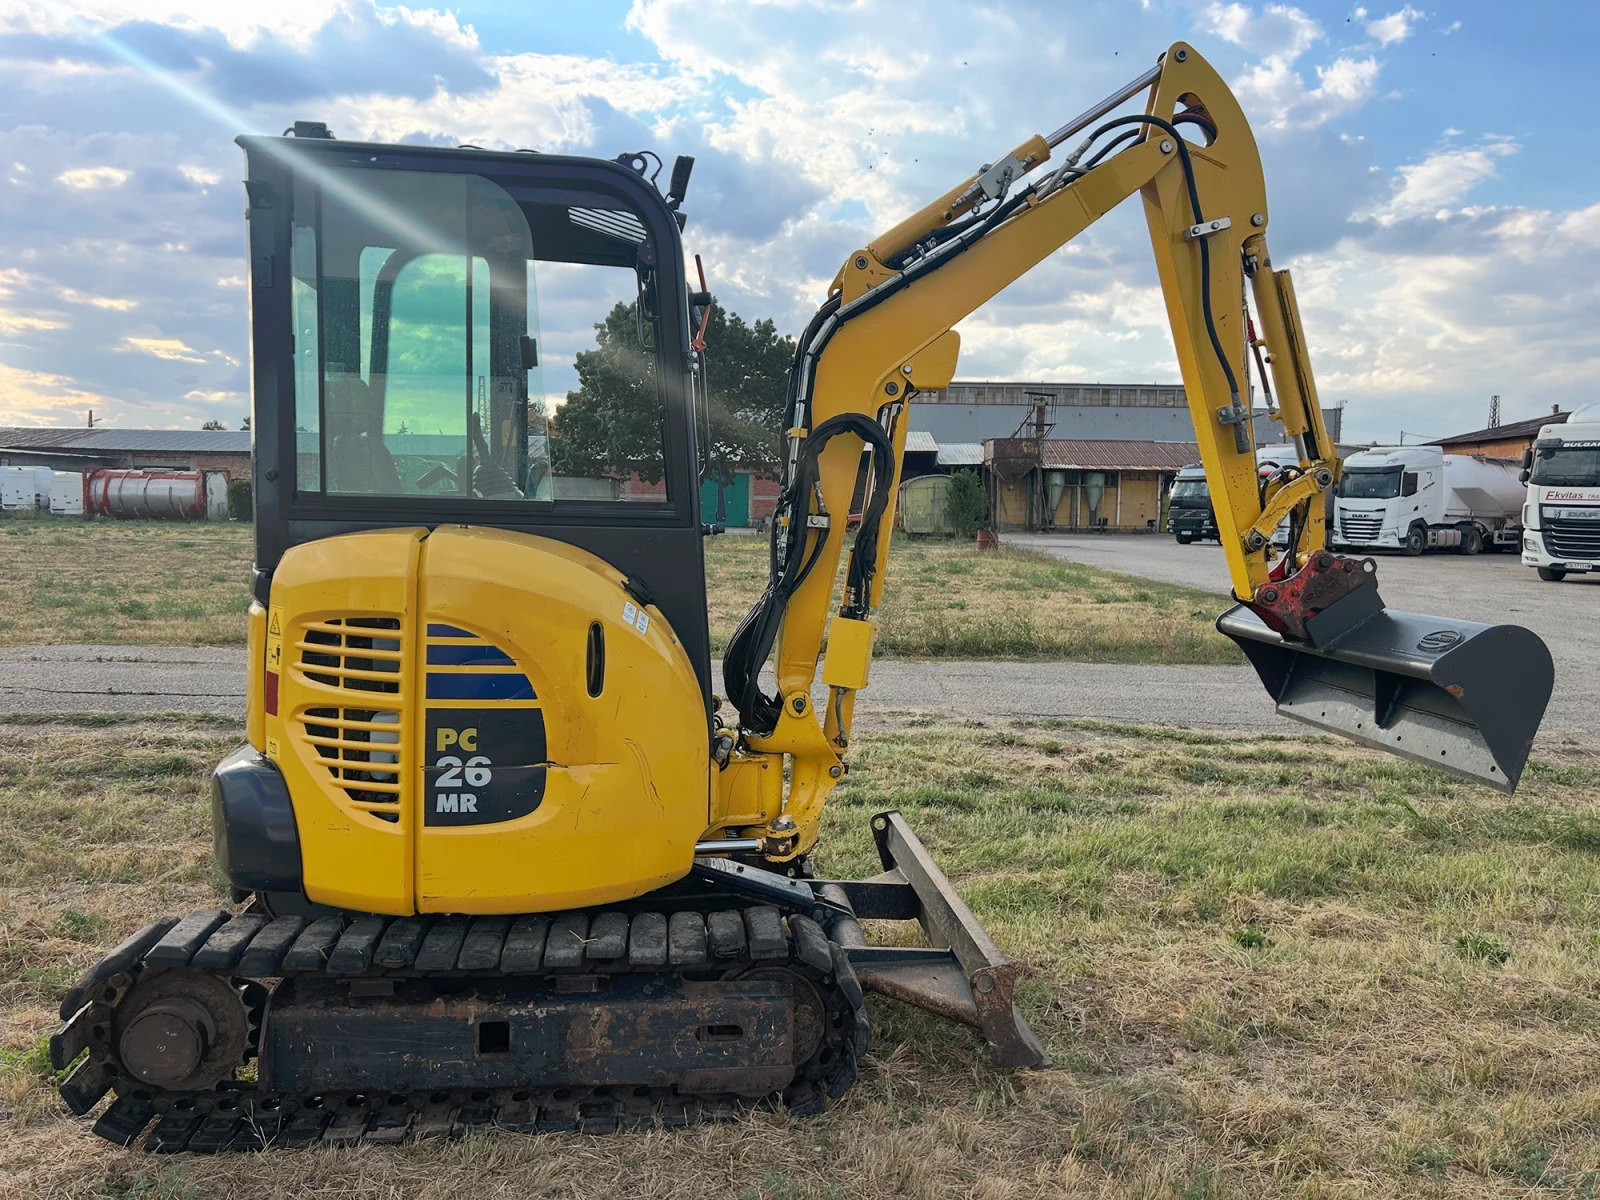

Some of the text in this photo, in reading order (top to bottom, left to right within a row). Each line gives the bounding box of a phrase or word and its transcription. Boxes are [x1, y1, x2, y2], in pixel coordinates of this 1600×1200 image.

[1546, 490, 1584, 500] Ekvitas
[436, 727, 477, 752] PC
[435, 755, 492, 787] 26
[436, 793, 478, 813] MR
